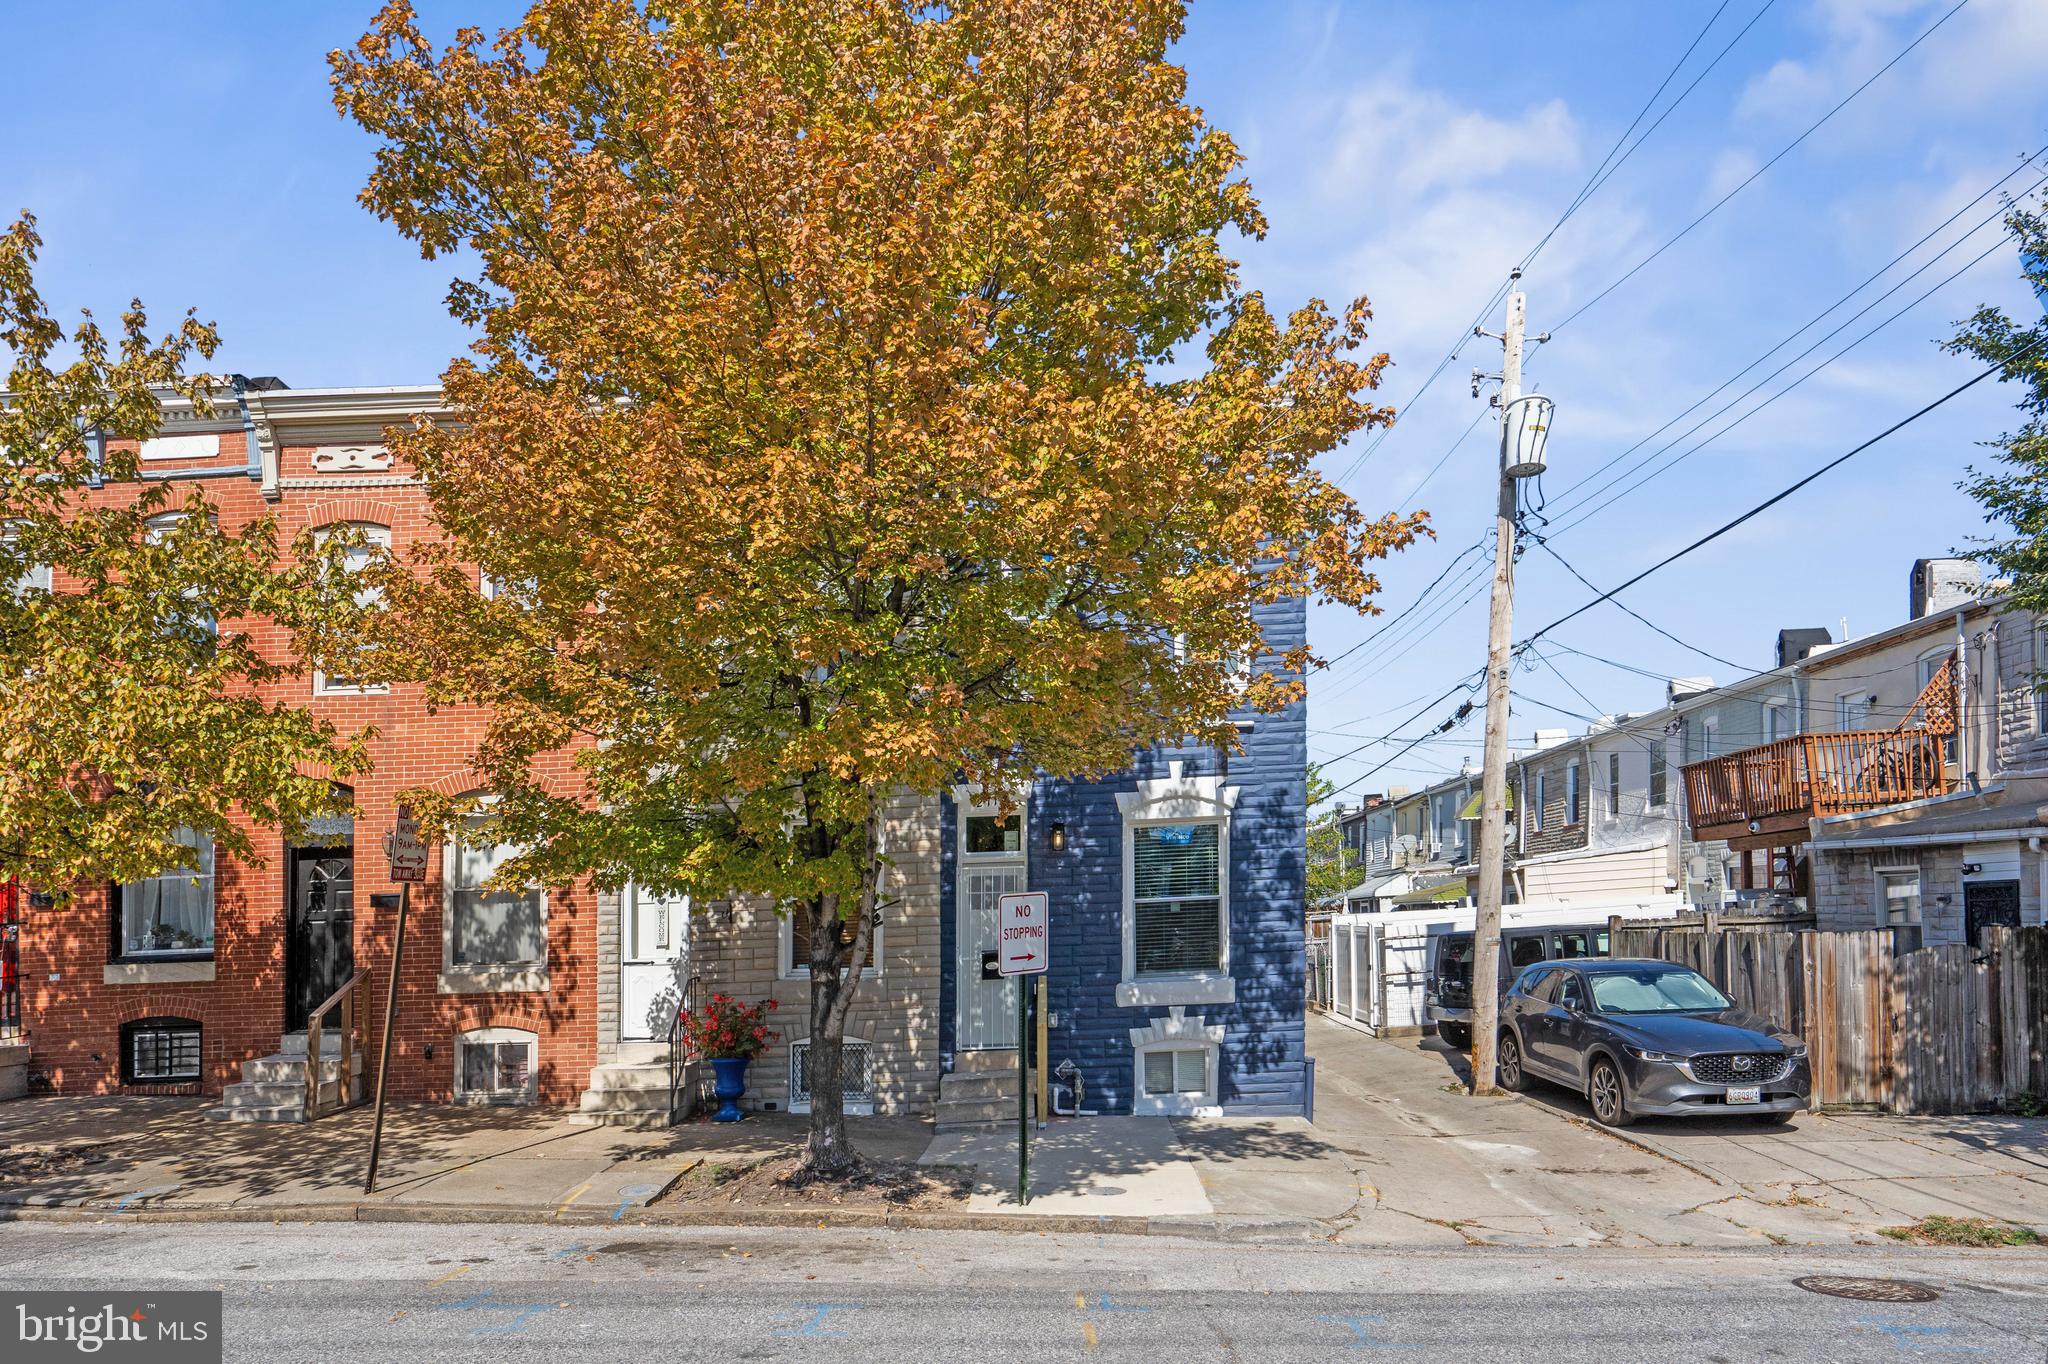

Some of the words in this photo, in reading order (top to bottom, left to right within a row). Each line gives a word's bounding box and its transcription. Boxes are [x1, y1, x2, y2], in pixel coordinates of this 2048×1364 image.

[399, 805, 409, 818] NO
[1015, 905, 1031, 918] NO
[657, 910, 666, 942] WELCOME
[1003, 925, 1043, 941] STOPPING
